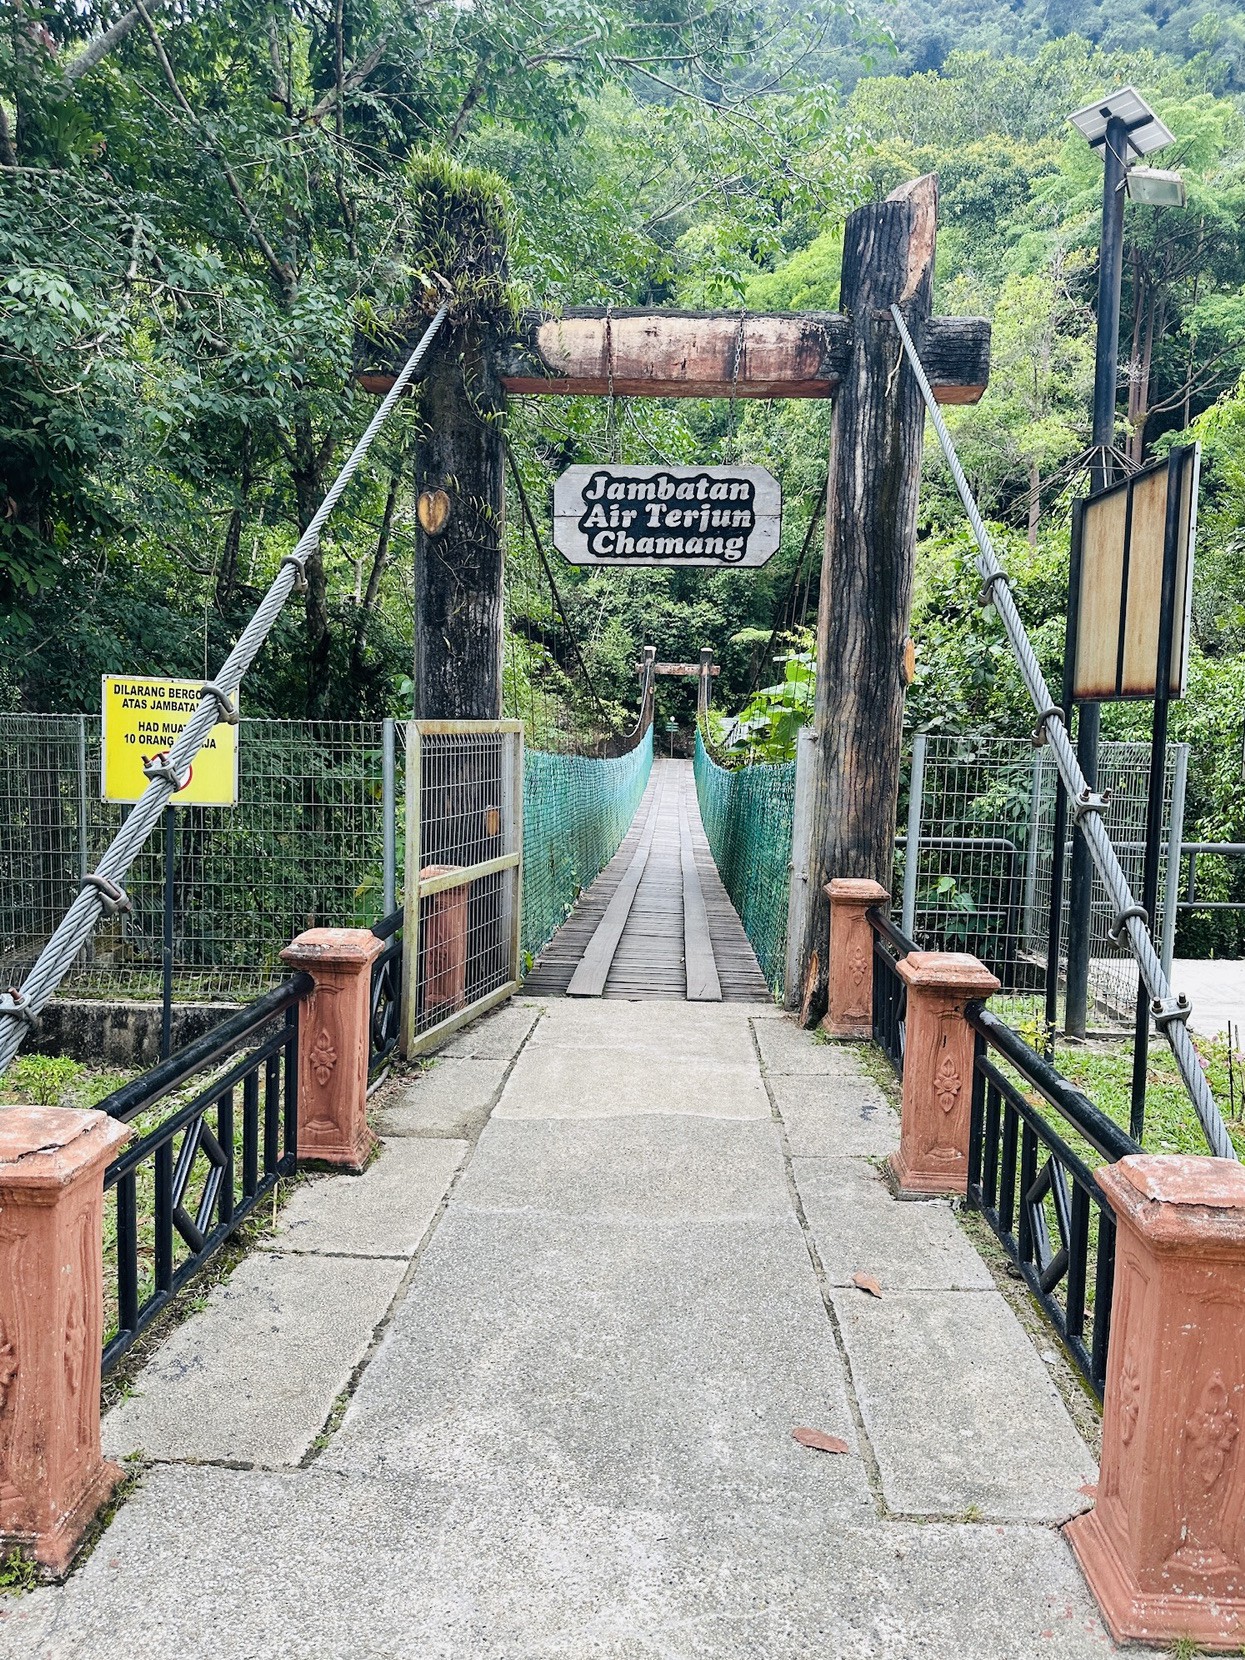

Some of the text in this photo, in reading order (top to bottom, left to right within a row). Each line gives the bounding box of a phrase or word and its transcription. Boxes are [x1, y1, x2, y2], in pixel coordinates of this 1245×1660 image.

[586, 476, 750, 501] Jambatan
[583, 502, 752, 532] Air Terjun
[592, 530, 744, 561] Chamang
[113, 684, 203, 700] DILARANG BERGO
[122, 699, 199, 712] ATAS JAMBATA
[138, 721, 187, 734] HAD MUA
[124, 733, 174, 745] 10 ORANG
